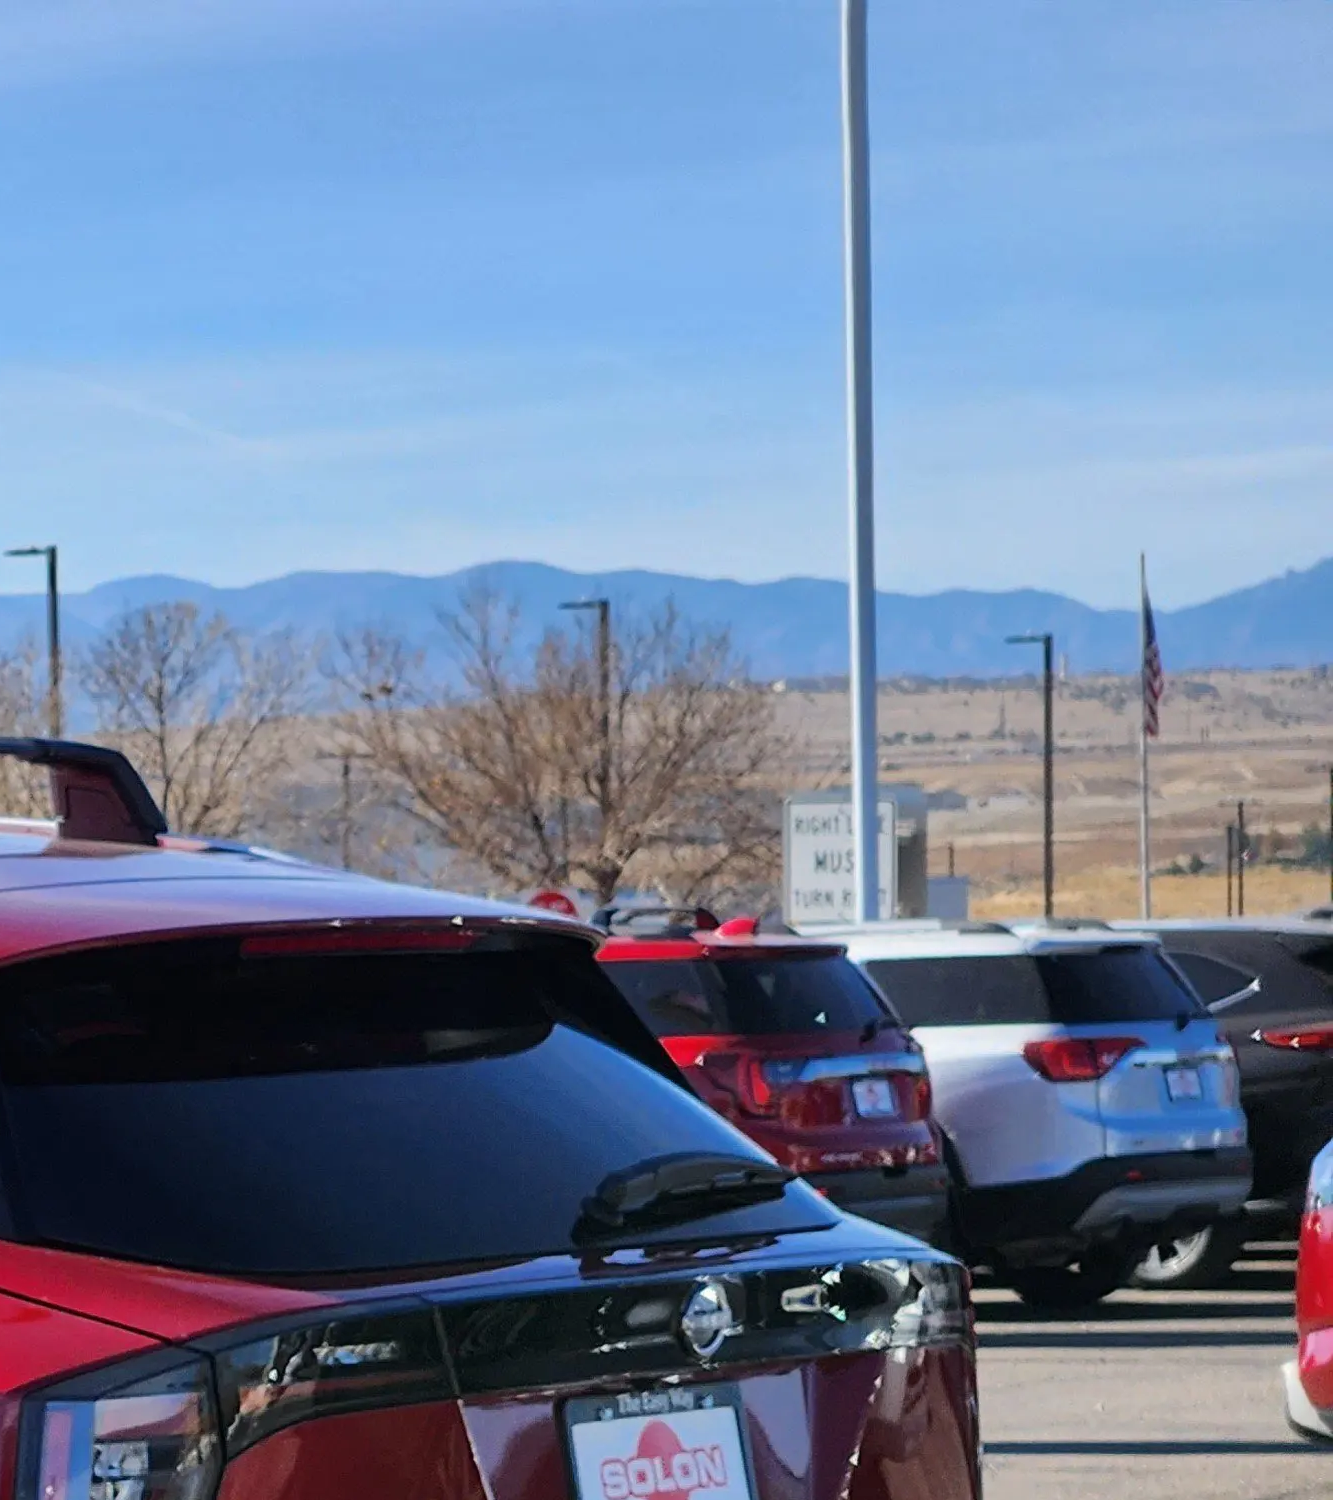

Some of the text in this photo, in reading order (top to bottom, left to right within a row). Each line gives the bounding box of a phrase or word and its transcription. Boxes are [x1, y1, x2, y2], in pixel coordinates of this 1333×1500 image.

[794, 815, 840, 835] RIGHT
[814, 849, 856, 873] MUS
[794, 888, 834, 908] TURN
